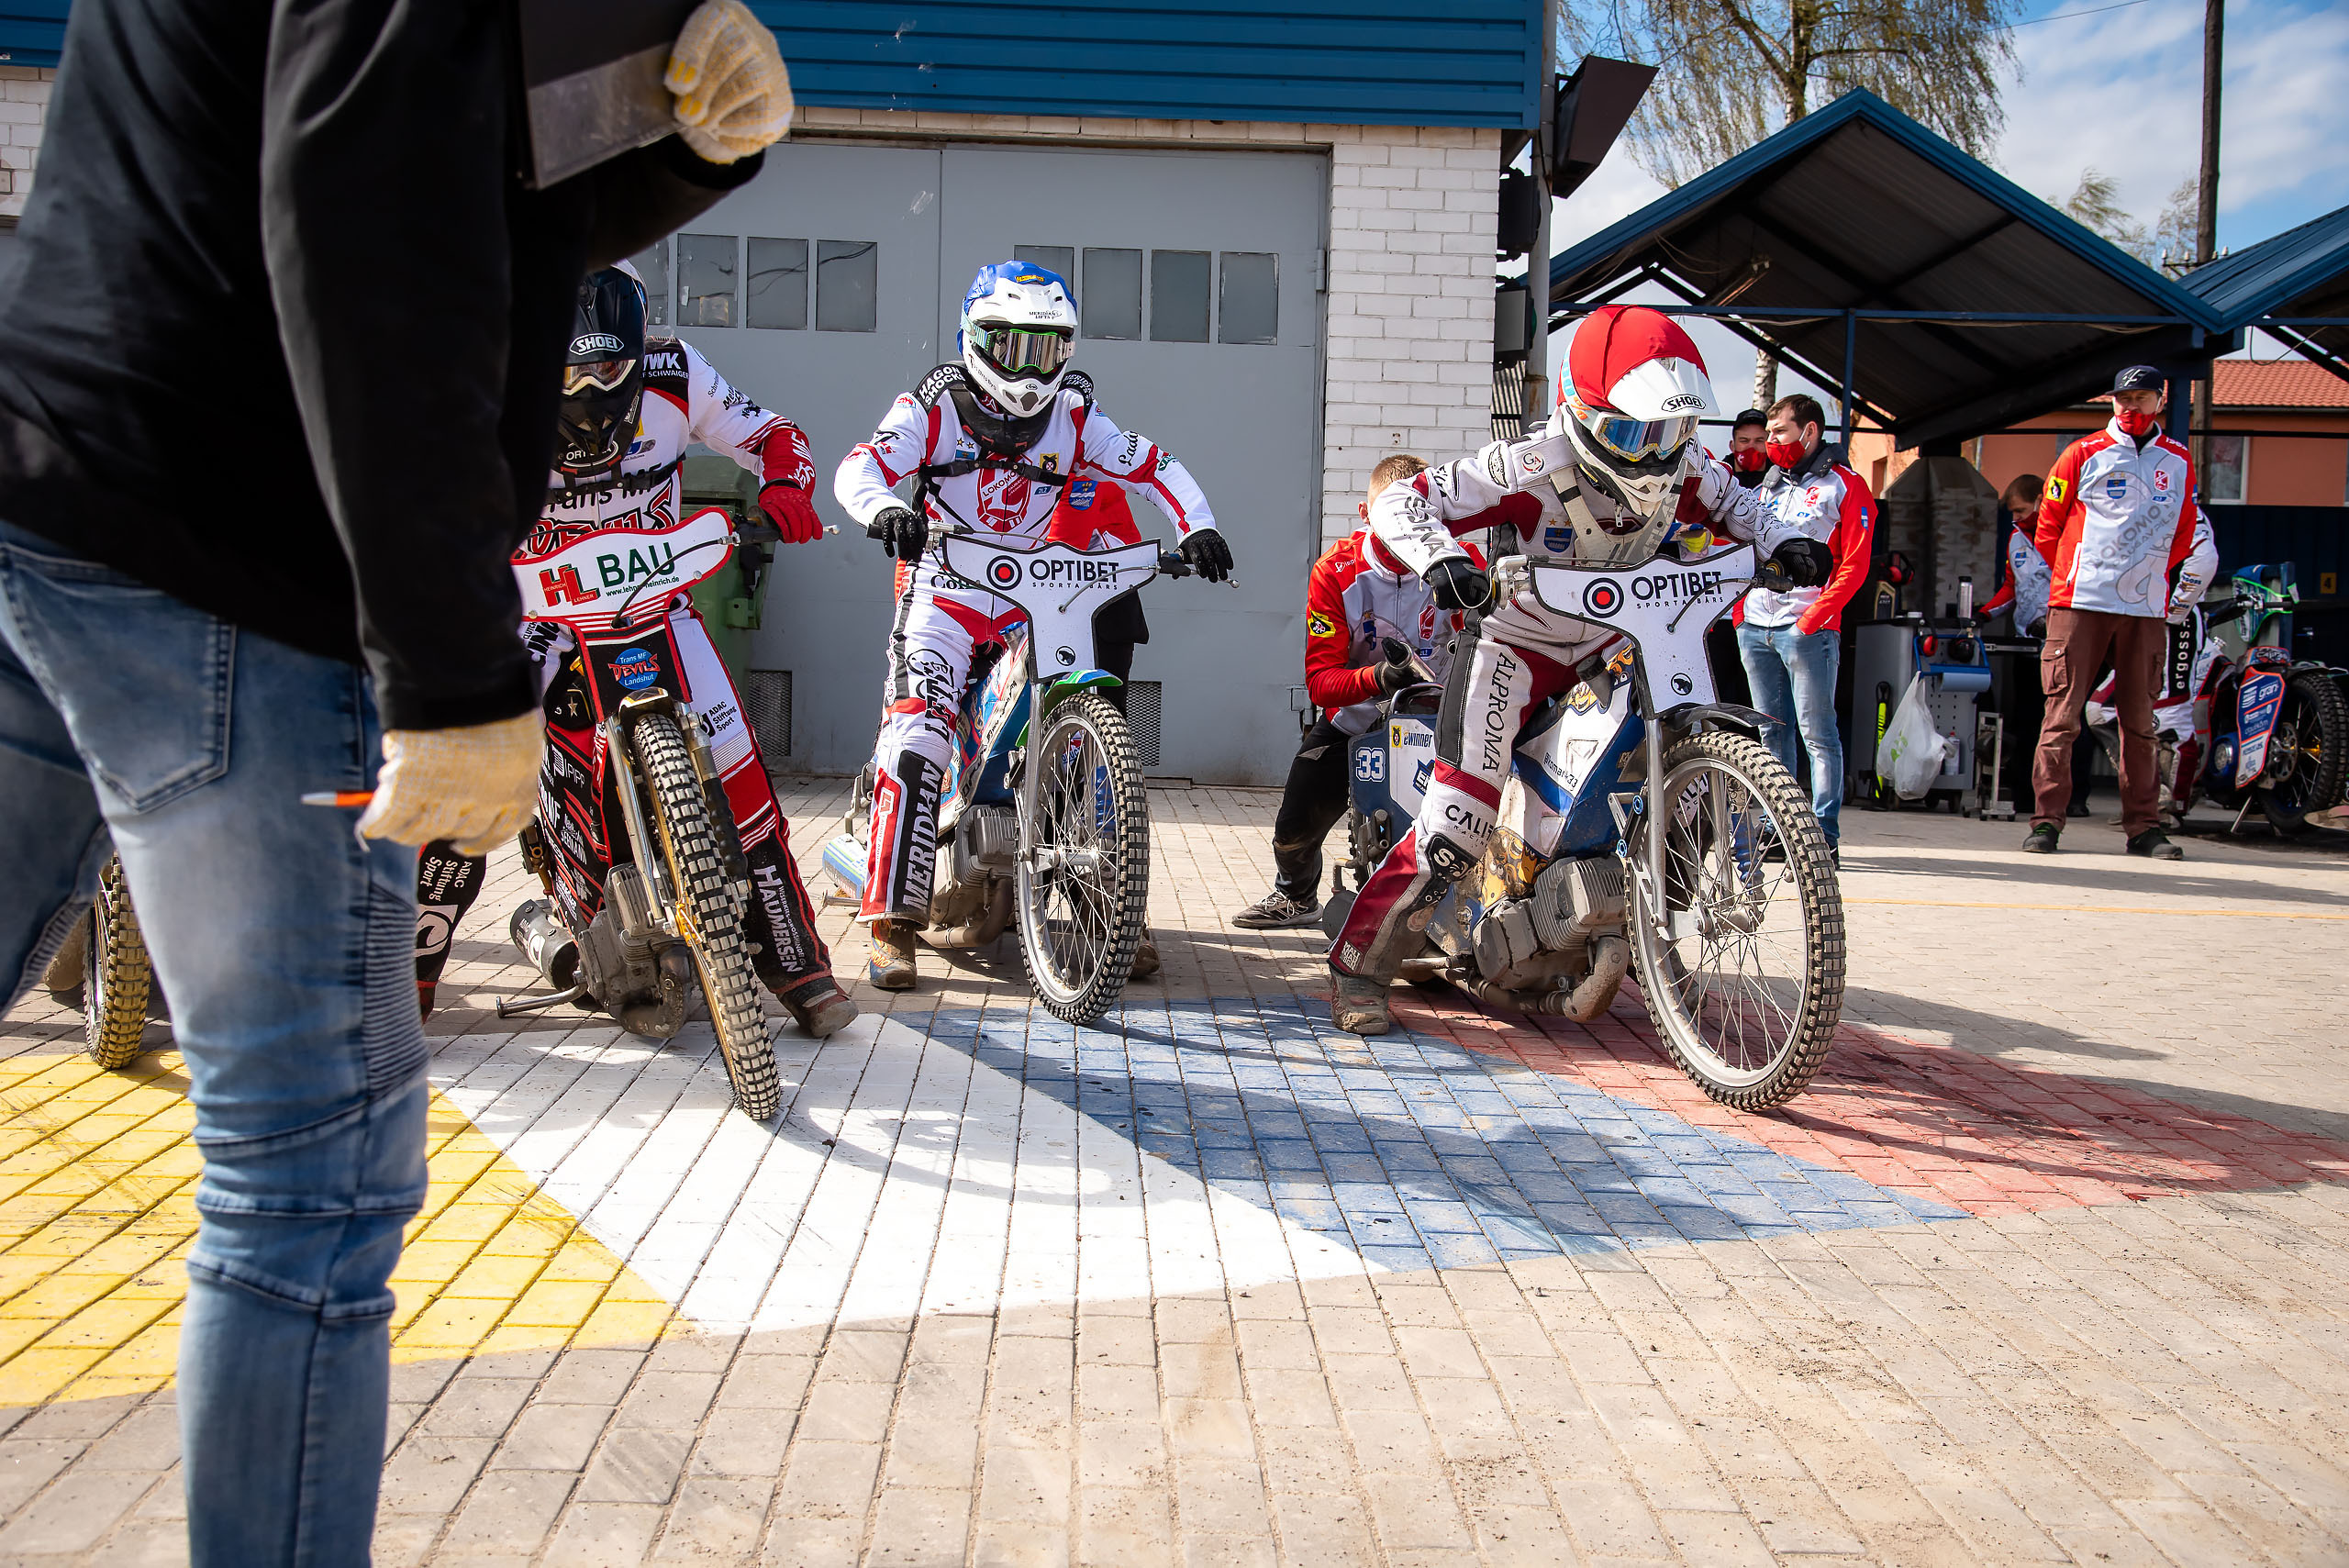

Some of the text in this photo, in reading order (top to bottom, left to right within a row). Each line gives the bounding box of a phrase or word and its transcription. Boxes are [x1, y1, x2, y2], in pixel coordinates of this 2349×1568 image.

[575, 336, 618, 353] SHOEI
[648, 369, 689, 380] SCHWAIGER
[918, 366, 961, 400] HAGON
[1666, 395, 1701, 410] SHOEI
[982, 470, 1017, 498] LOKOMO
[596, 541, 675, 588] BAU
[1030, 559, 1119, 583] OPTIBET
[543, 583, 566, 593] HEINRICH
[573, 594, 595, 603] LEHNER
[1631, 571, 1721, 601] OPTIBET
[1636, 599, 1689, 609] SPORTA
[607, 652, 662, 682] DEVILS
[619, 651, 647, 664] Trans MF
[624, 673, 654, 686] Landshut
[708, 700, 728, 717] ADAC
[712, 706, 738, 725] Stiftung
[1482, 651, 1517, 773] ALPROMA
[716, 716, 735, 732] Sport
[1355, 746, 1386, 783] 33
[902, 760, 944, 913] MERIDIAN
[419, 856, 443, 887] Sport
[429, 860, 459, 902] Stiftung
[453, 861, 473, 888] ADAC
[753, 864, 804, 973] HAUMERSEN
